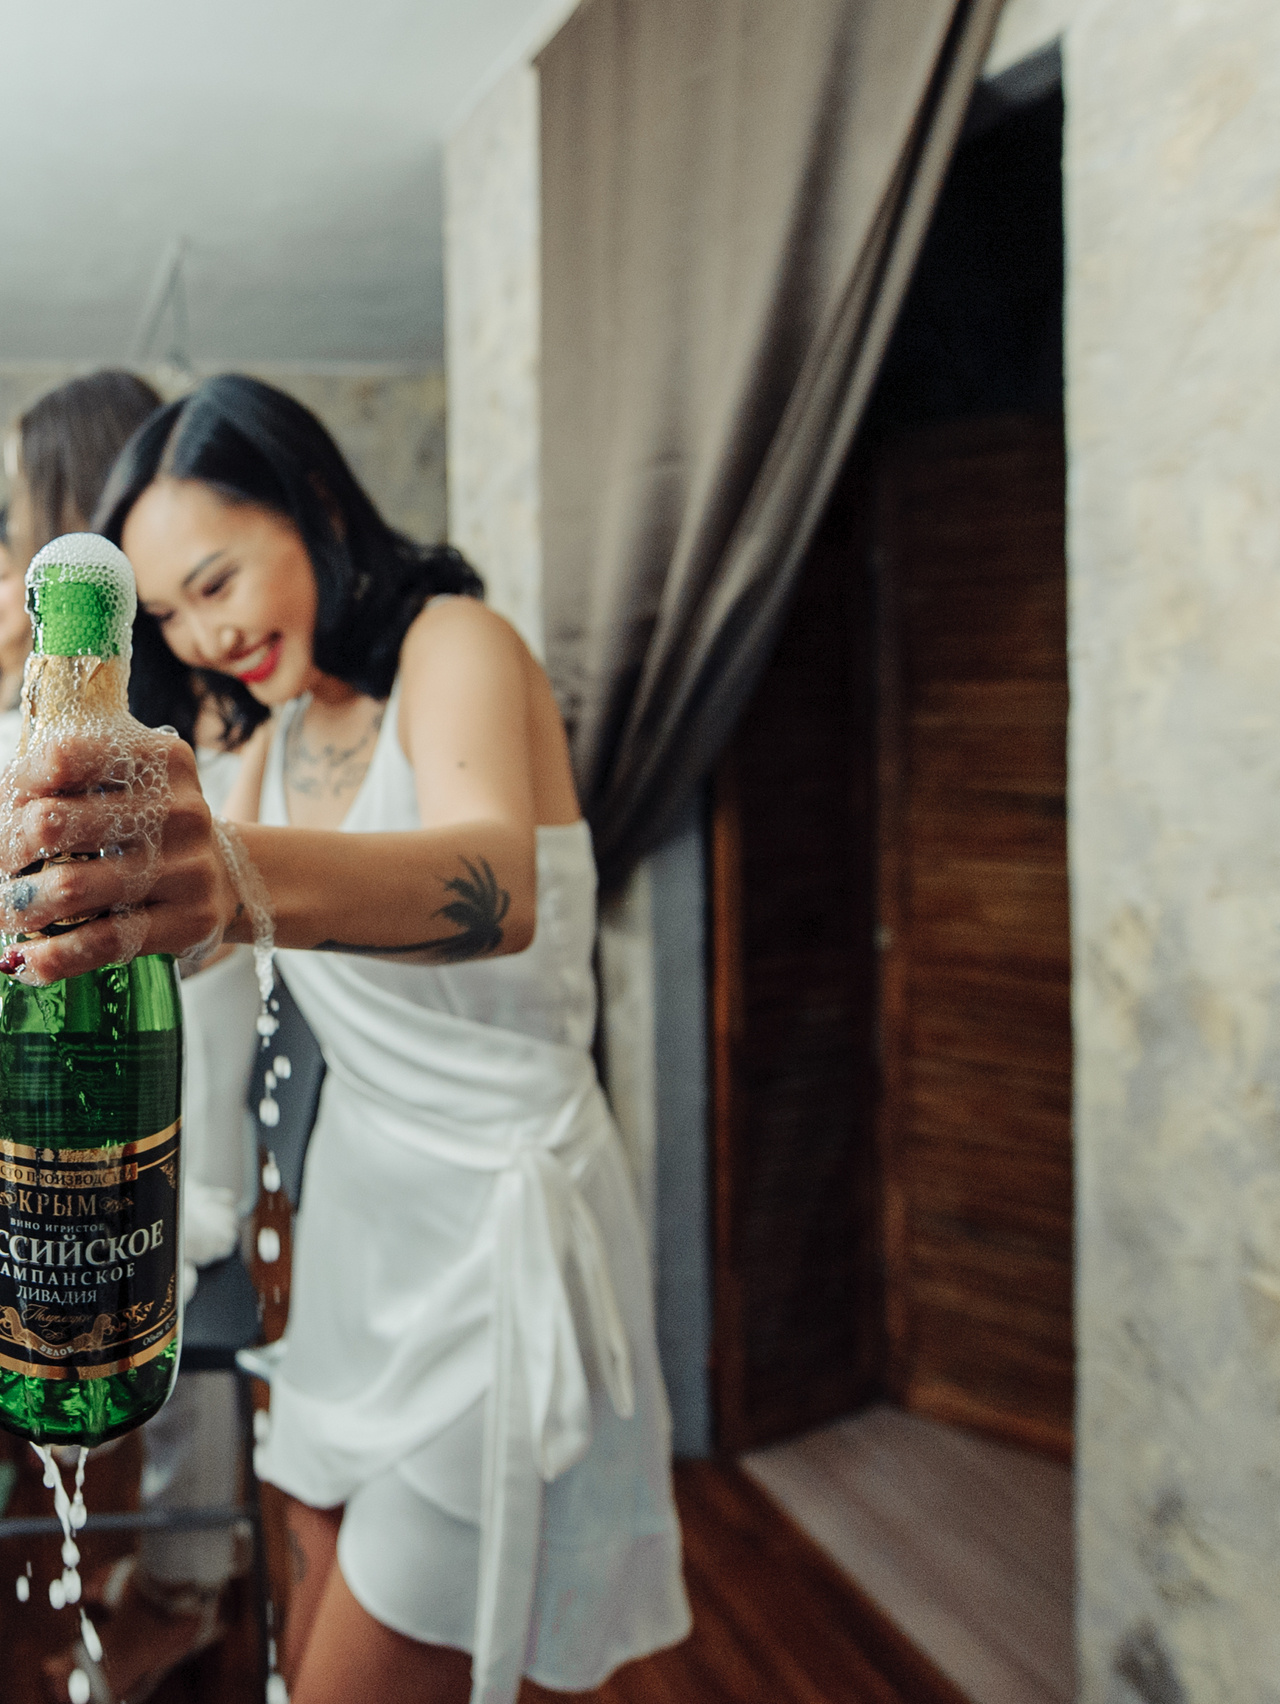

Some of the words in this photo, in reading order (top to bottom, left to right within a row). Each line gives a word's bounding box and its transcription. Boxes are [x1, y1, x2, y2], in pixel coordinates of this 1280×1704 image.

[18, 1189, 97, 1217] КРЫМ
[10, 1217, 41, 1231] ВИНО
[45, 1222, 105, 1234] ИГРИСТОЕ
[16, 1285, 98, 1306] ЛИВАДИЯ
[39, 1344, 74, 1357] БЕЛОЕ
